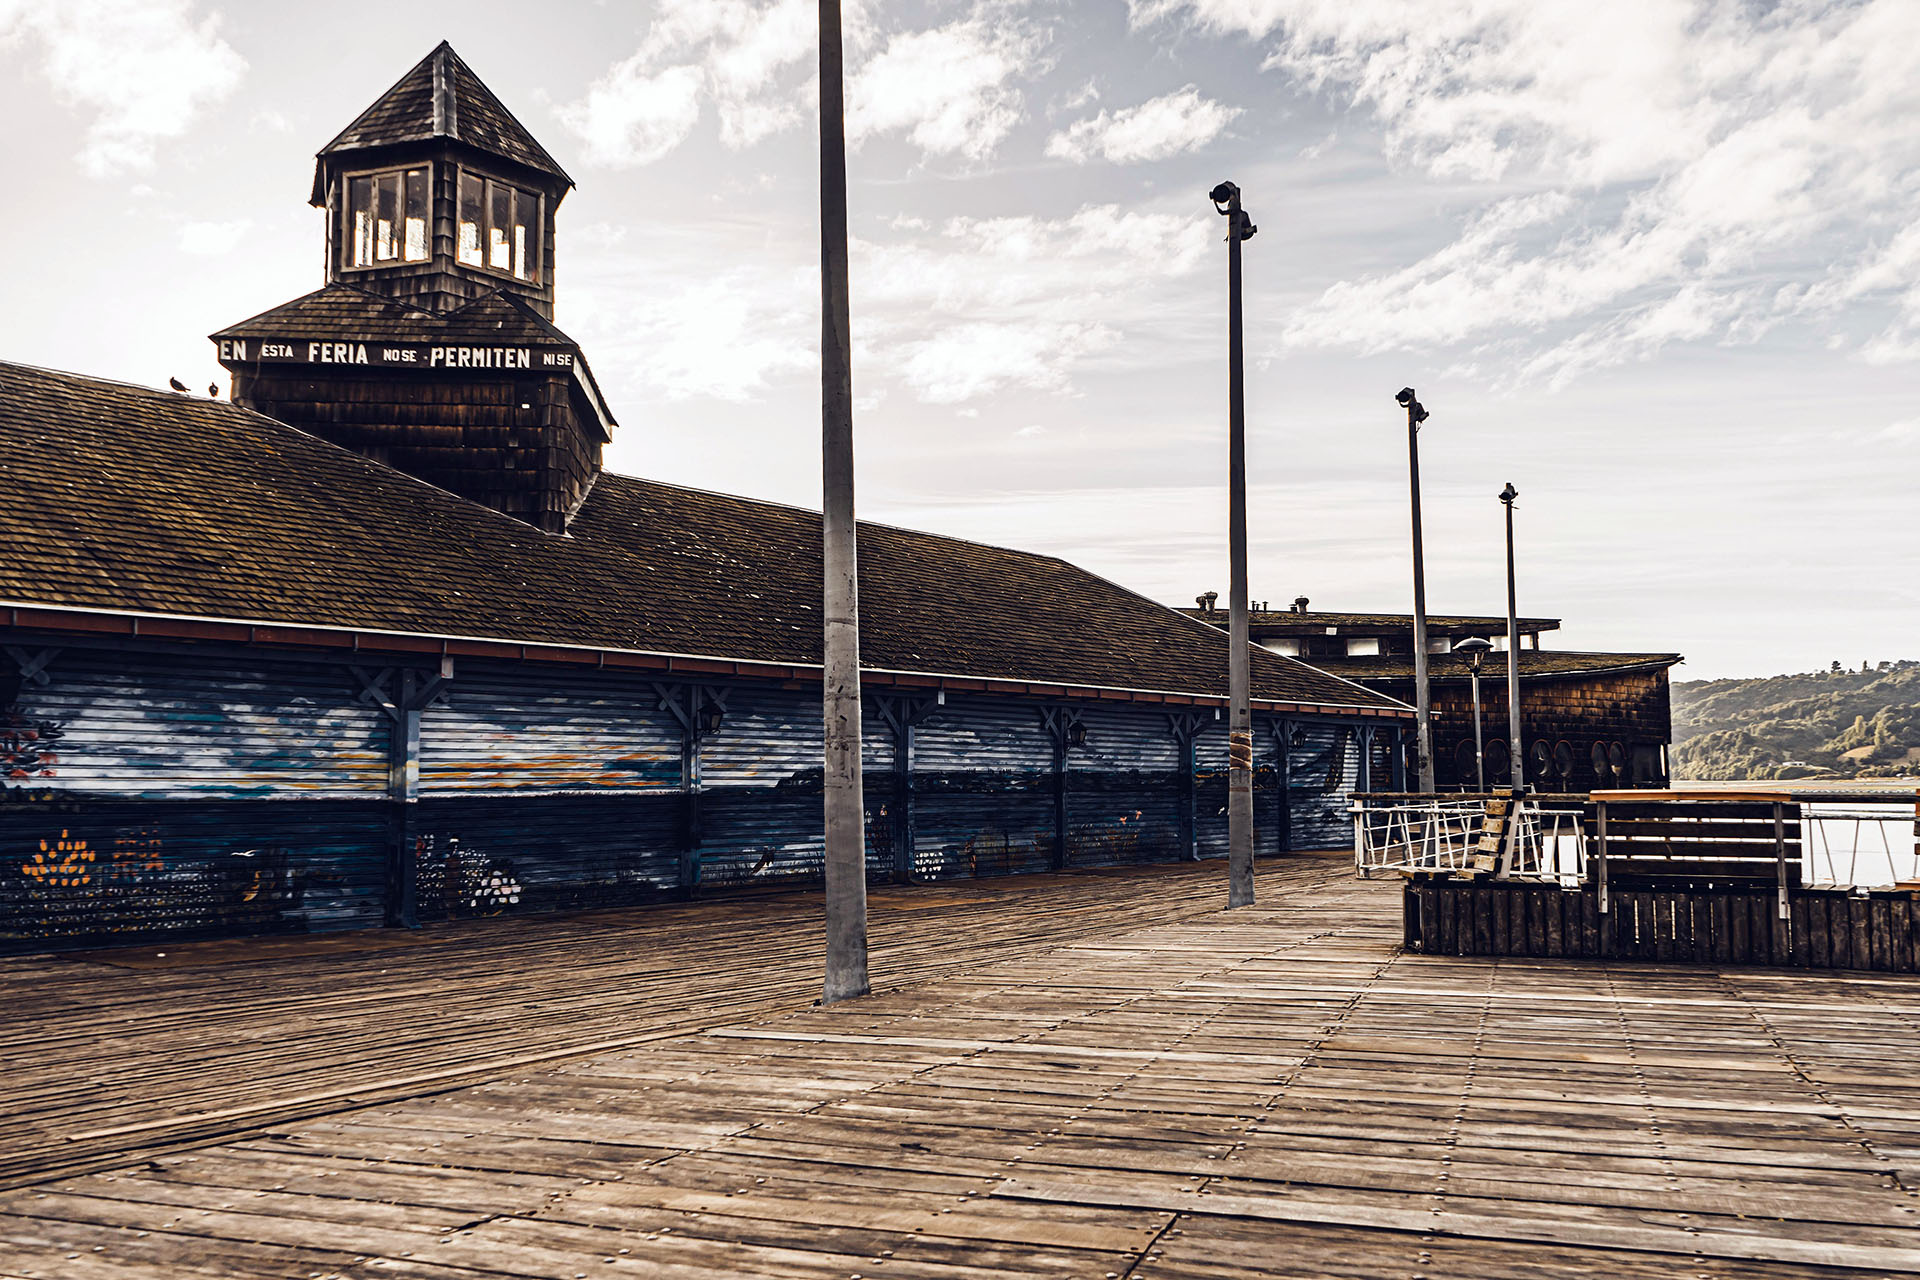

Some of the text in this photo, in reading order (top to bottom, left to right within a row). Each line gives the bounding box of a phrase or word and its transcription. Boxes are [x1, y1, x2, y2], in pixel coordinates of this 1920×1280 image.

[219, 340, 247, 361] EN
[261, 344, 294, 358] ESTA
[308, 342, 369, 365] FERIA
[430, 347, 530, 369] PERMITEN
